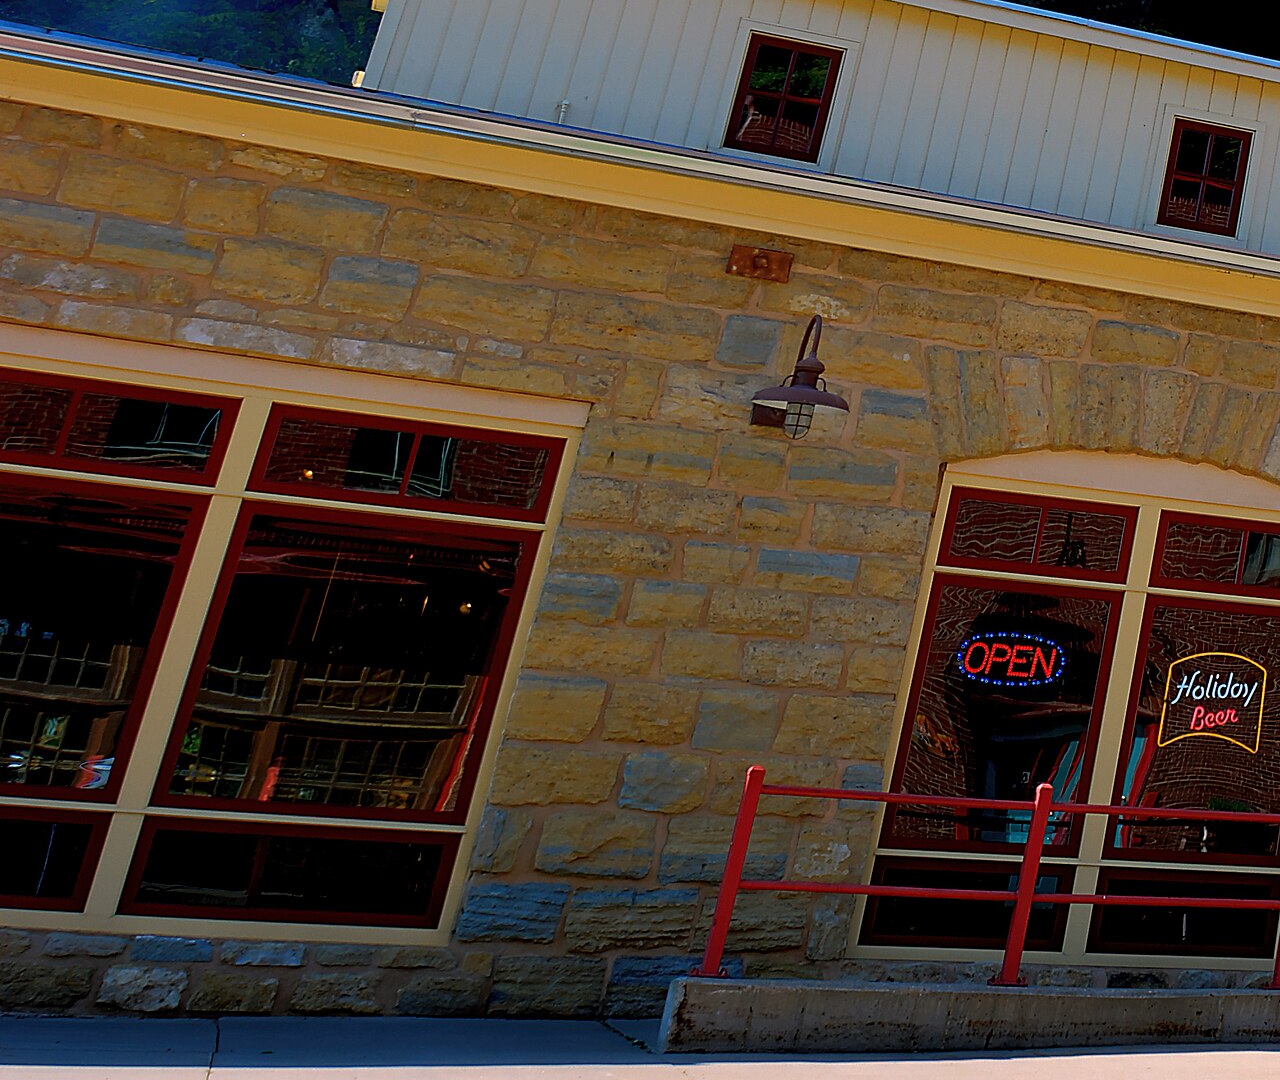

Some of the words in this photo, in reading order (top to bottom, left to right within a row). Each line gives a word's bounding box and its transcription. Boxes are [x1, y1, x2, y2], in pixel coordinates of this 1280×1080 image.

[964, 641, 1057, 679] OPEN
[1171, 670, 1258, 707] Holiday
[1190, 706, 1239, 731] Beer
